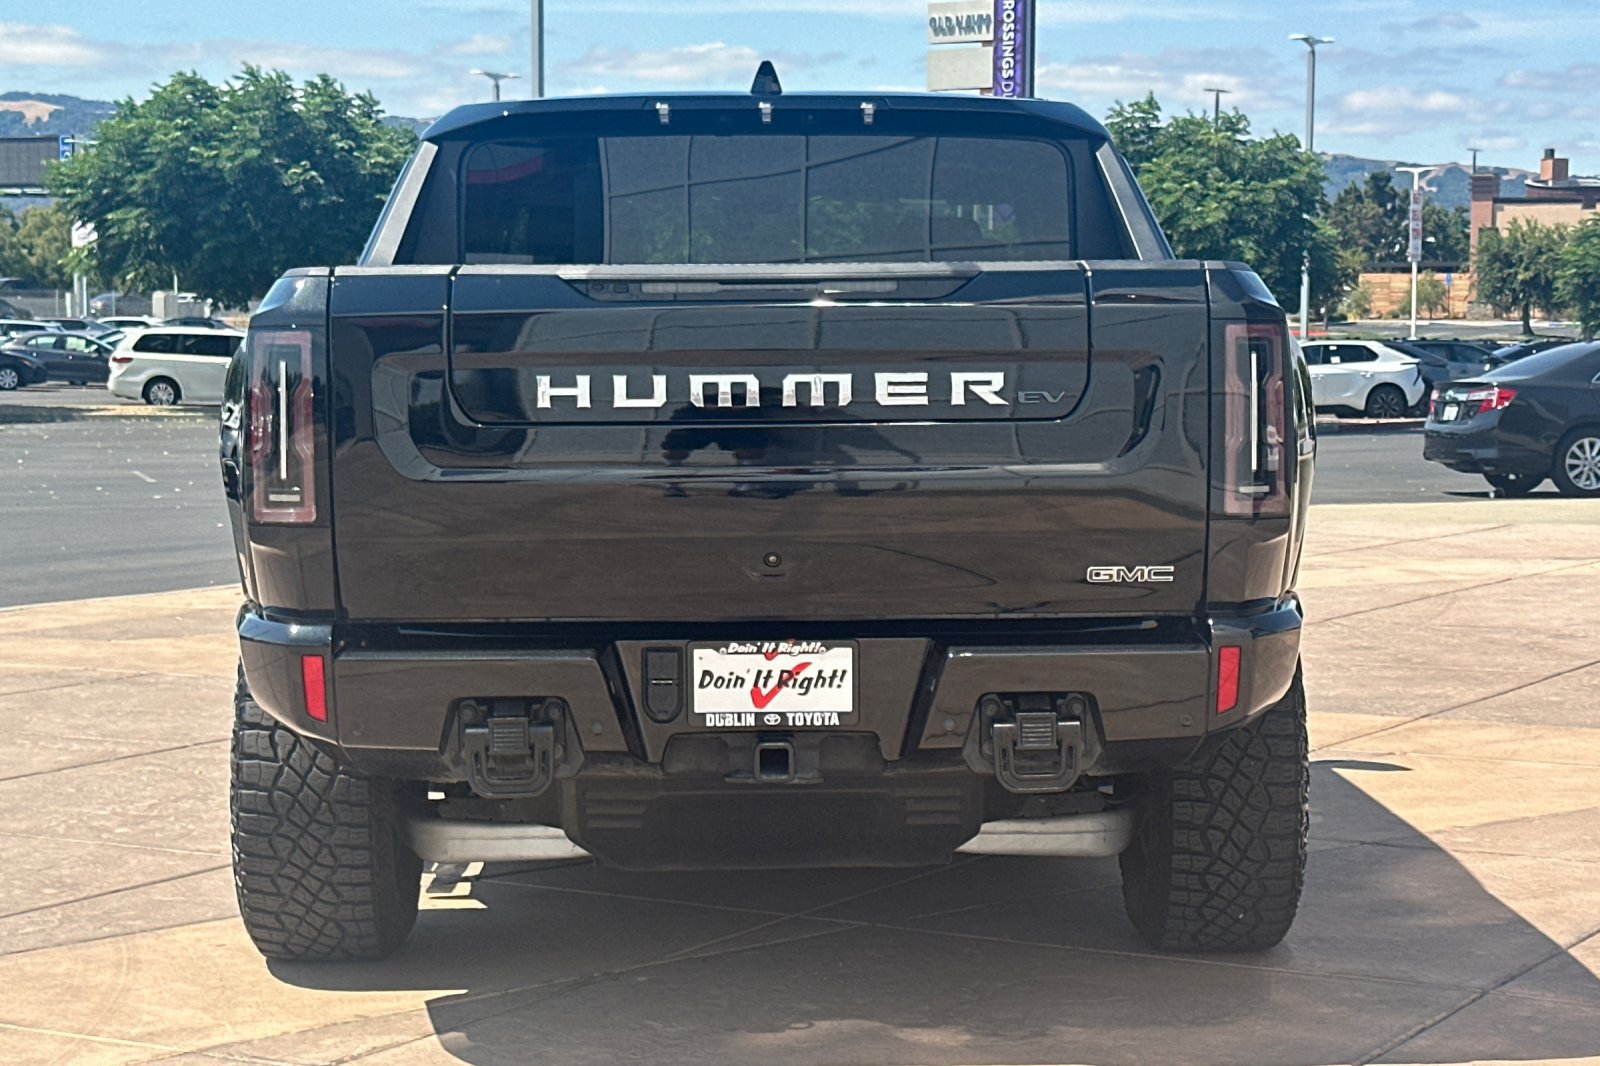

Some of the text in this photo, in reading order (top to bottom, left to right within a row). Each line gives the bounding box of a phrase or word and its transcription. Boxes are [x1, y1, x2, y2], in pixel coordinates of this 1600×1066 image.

[1001, 0, 1015, 79] ROSSINGS
[535, 371, 1066, 409] HUMMER EV
[1087, 565, 1175, 582] GMC
[761, 642, 776, 654] It
[777, 641, 821, 656] Right!
[698, 668, 847, 696] Doin' It Right!
[705, 712, 840, 727] DUBLIN TOYOTA
